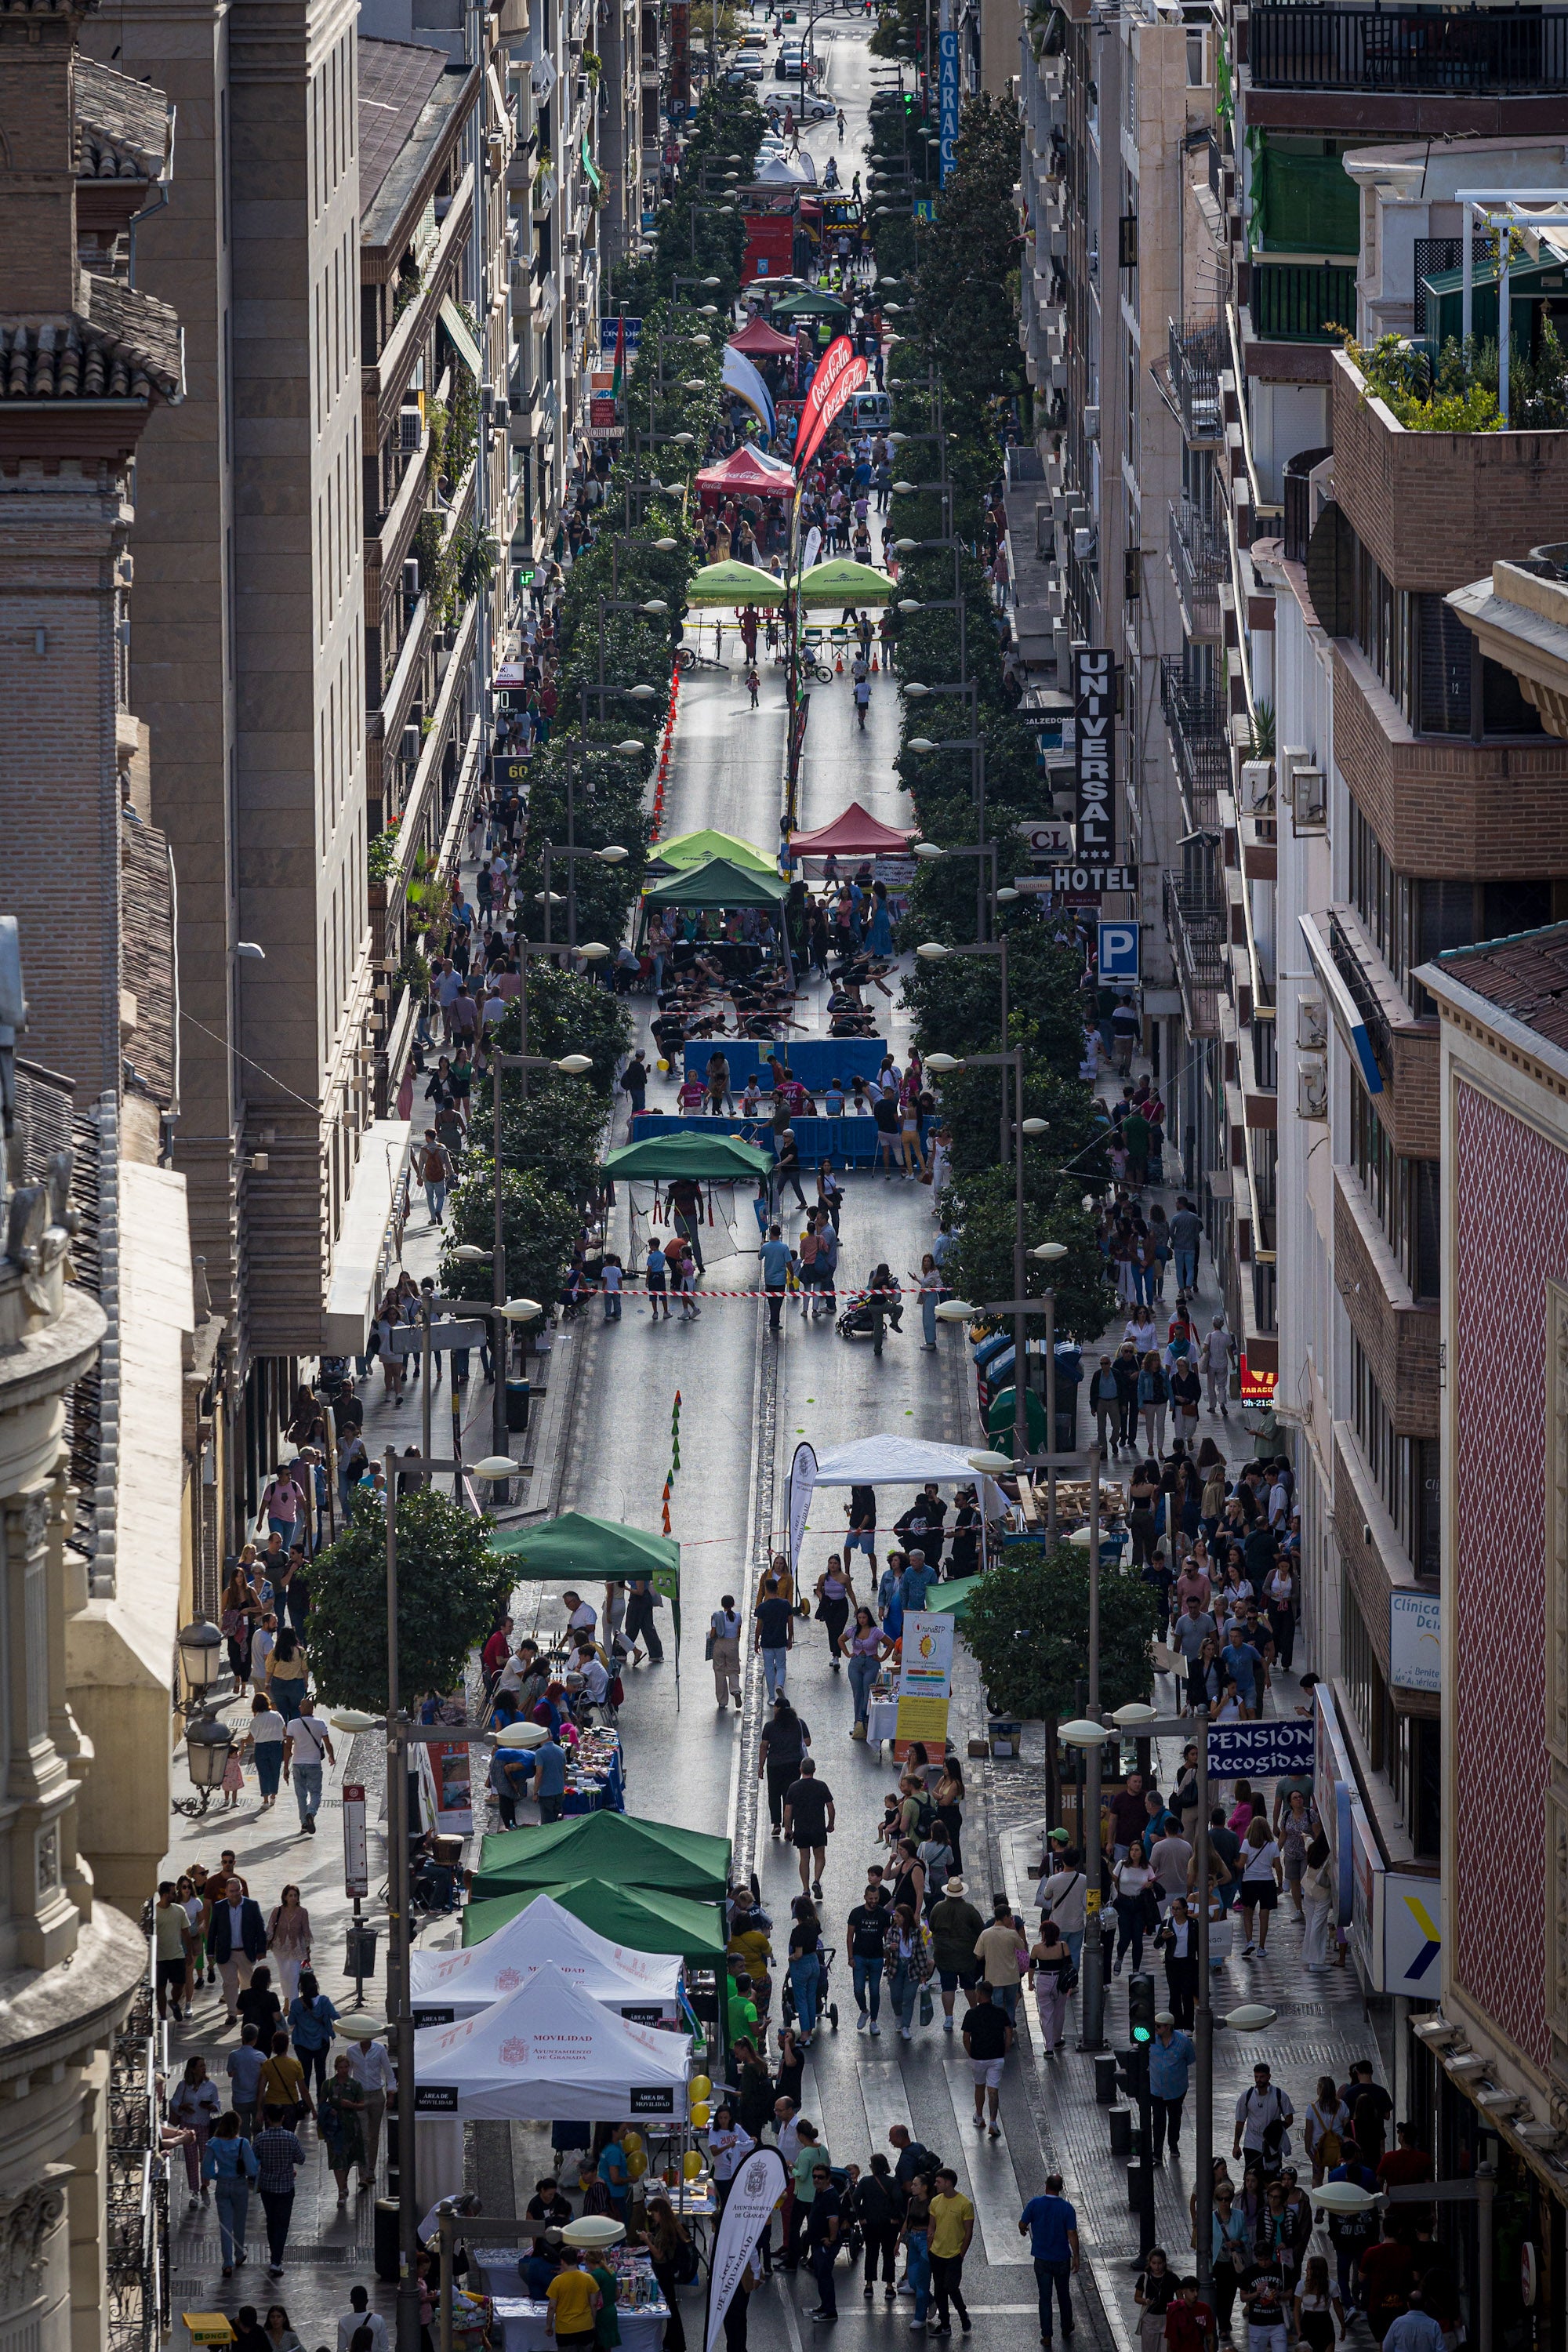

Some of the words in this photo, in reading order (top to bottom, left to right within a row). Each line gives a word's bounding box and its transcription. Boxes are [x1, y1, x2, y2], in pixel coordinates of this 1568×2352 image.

[1080, 654, 1109, 843] UNIVERSAL
[1031, 831, 1068, 849] CL
[1054, 868, 1134, 891] HOTEL
[1103, 930, 1134, 967] P
[1393, 1598, 1440, 1615] Clínica
[1207, 1726, 1313, 1749] PENSIÓN
[1207, 1751, 1315, 1773] Recogidas
[717, 2295, 726, 2311] DE
[724, 2235, 753, 2296] MOVILIDAD
